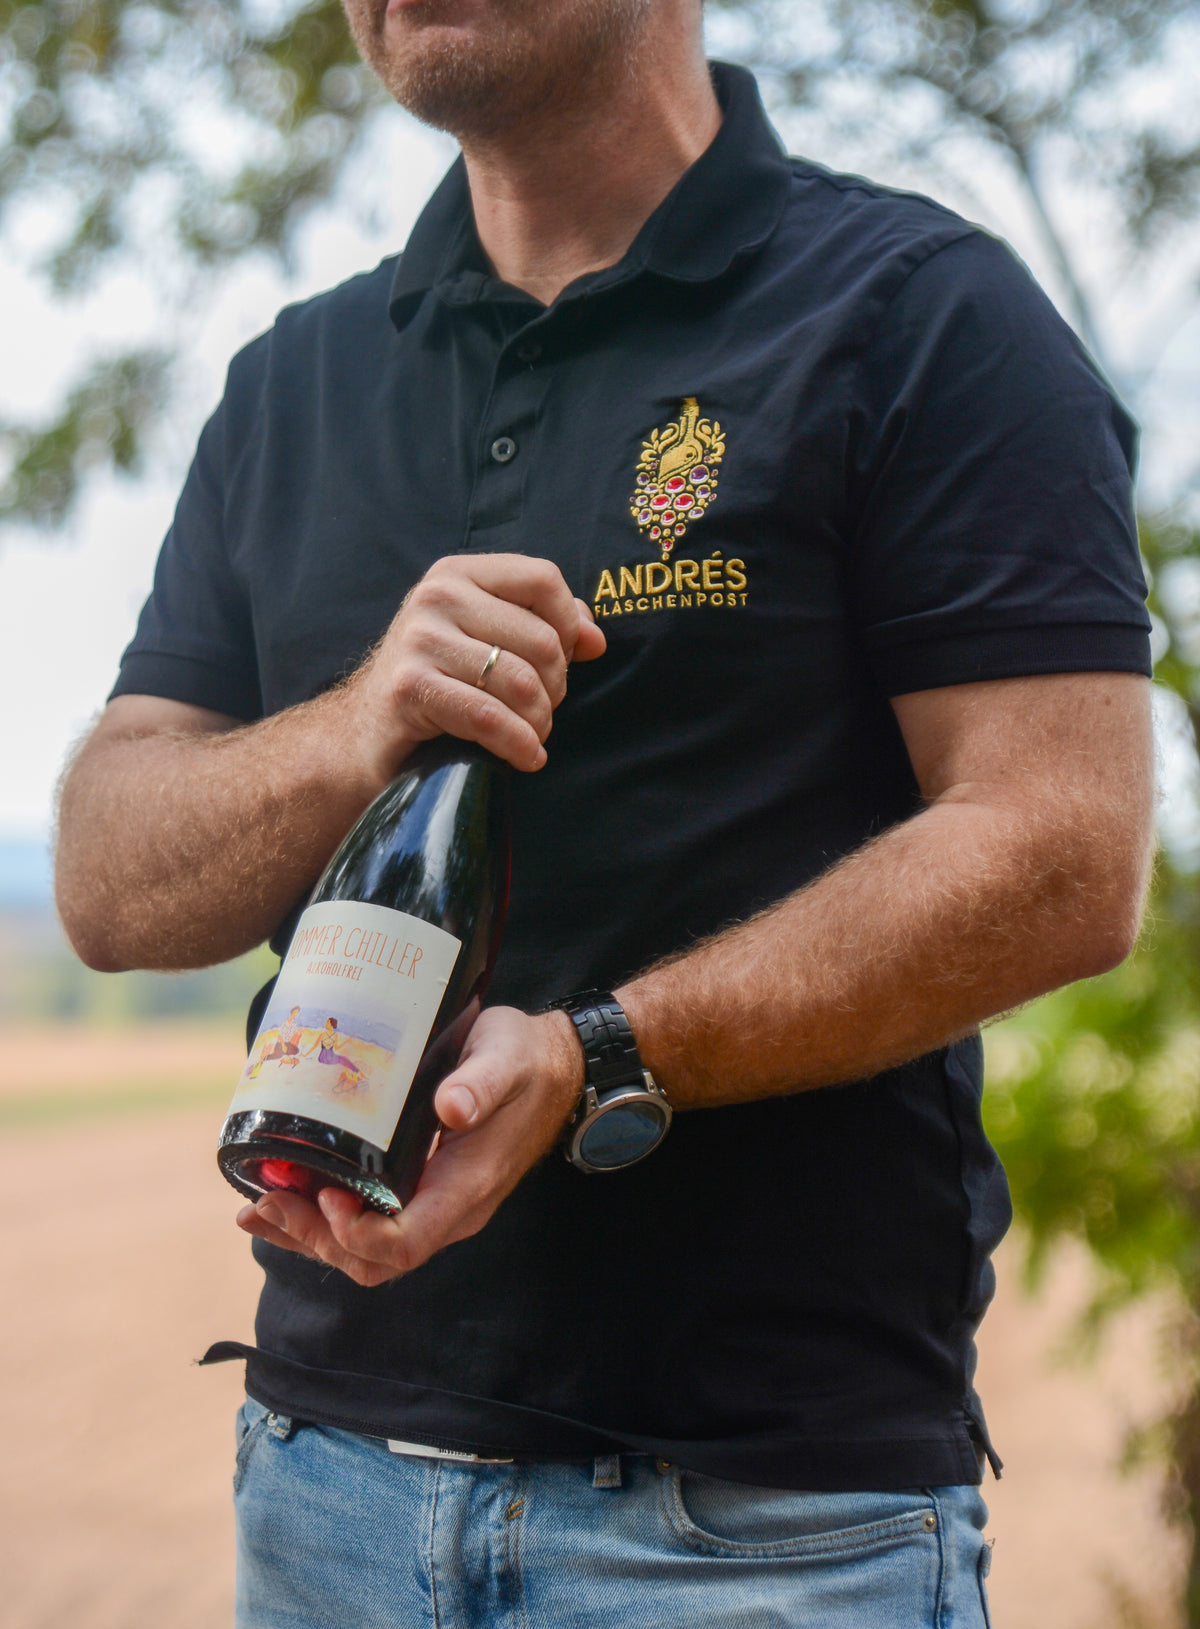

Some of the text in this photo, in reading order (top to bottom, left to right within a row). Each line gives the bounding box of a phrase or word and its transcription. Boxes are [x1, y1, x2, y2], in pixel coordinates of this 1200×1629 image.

[595, 550, 748, 602] ANDRÉS
[594, 592, 749, 617] FLASCHENPOST
[288, 924, 424, 980] UMMER CHILLER
[305, 961, 364, 981] ALKOHOLFREI
